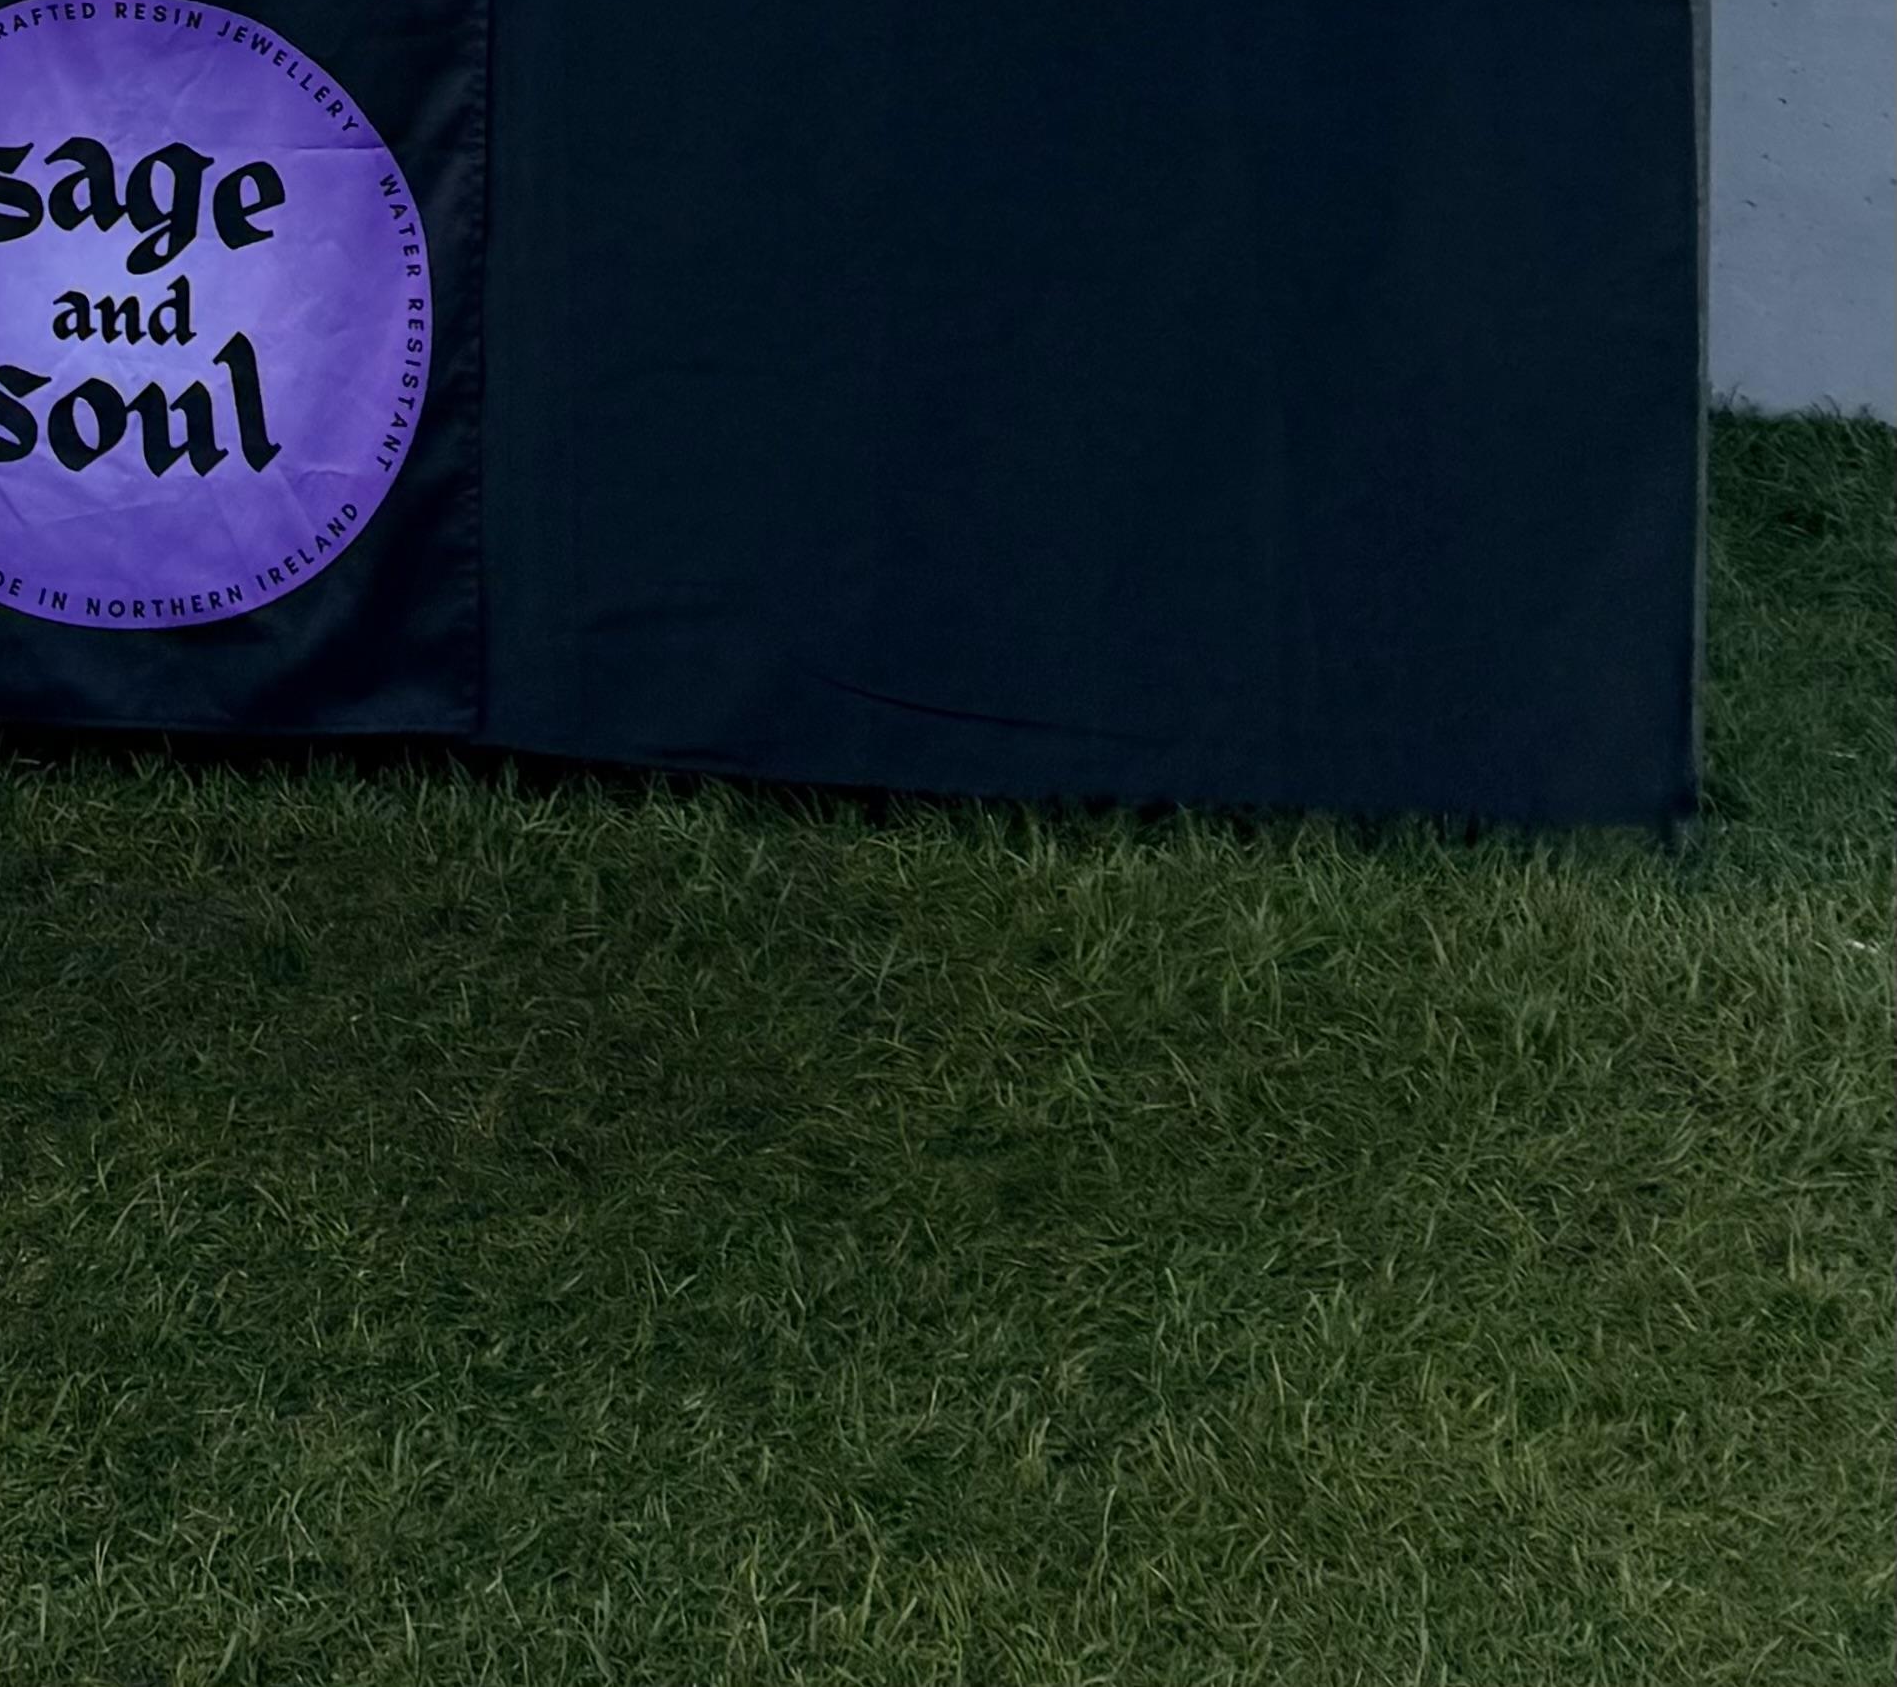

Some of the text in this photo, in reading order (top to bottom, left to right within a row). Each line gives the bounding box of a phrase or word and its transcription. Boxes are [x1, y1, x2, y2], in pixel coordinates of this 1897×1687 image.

[114, 1, 203, 31] RESIN
[217, 20, 359, 132] JEWELLERY
[52, 273, 197, 346] and
[375, 173, 426, 474] WATER RESISTANT
[38, 586, 69, 611] IN
[85, 583, 243, 620] NORTHERN
[255, 501, 360, 594] IRELAND
